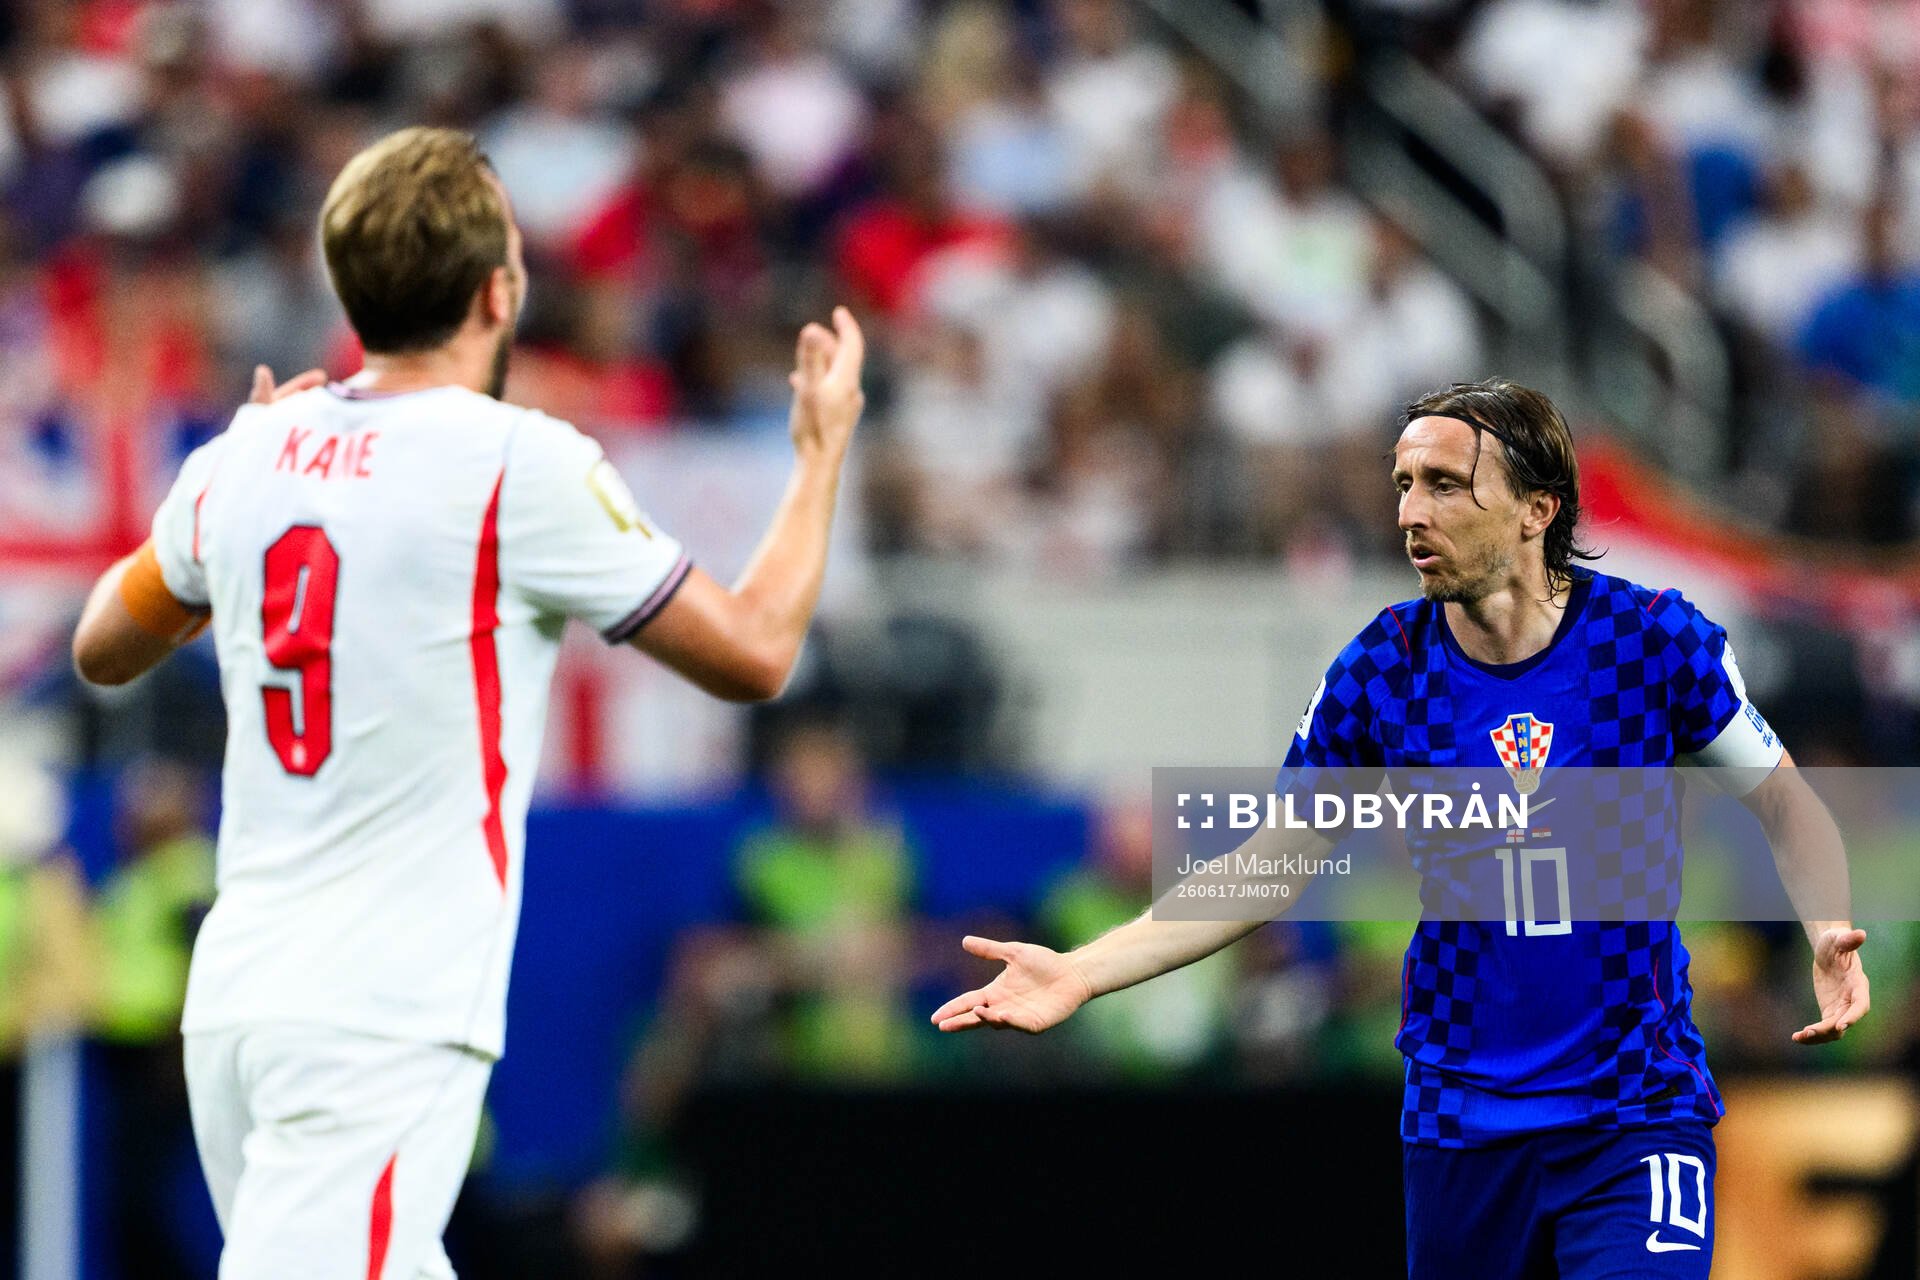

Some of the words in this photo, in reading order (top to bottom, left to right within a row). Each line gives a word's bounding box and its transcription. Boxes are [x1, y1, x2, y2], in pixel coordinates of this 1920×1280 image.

[262, 523, 340, 778] 9
[1516, 722, 1529, 763] HNS
[1494, 847, 1572, 937] 10
[1640, 1153, 1707, 1239] 10
